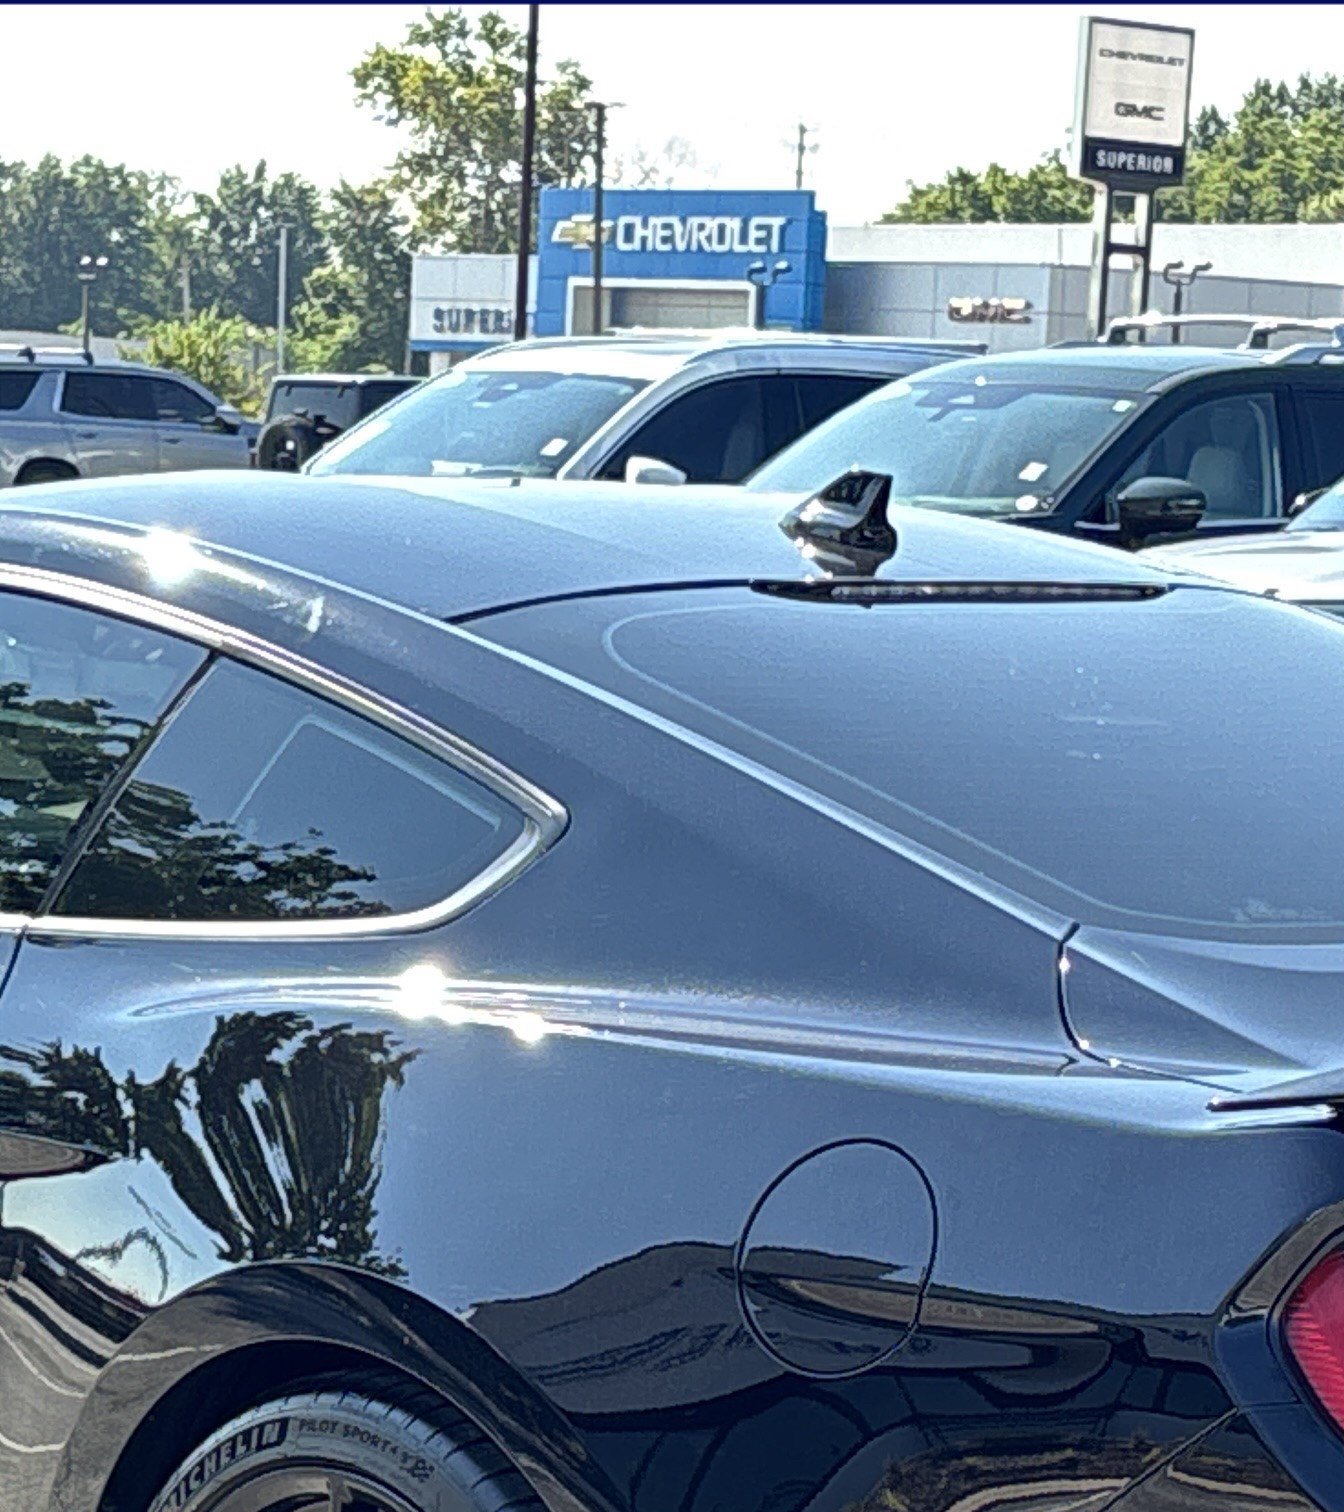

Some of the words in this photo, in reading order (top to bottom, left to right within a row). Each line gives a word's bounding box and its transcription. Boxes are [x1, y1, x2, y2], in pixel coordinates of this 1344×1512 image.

[1114, 101, 1166, 122] GMC
[1095, 149, 1174, 175] SUPERIOR
[615, 215, 788, 254] CHEVROLET
